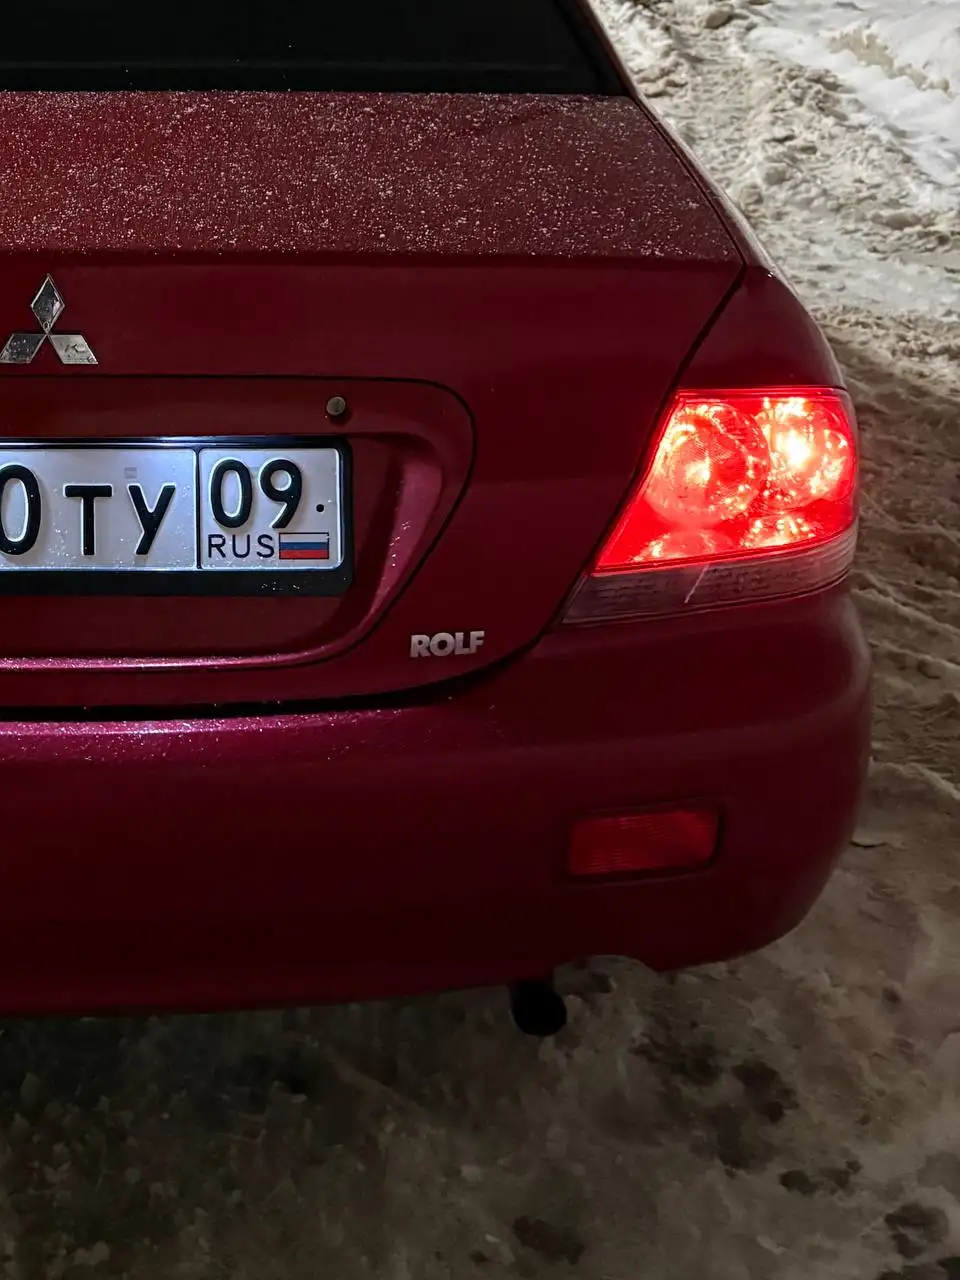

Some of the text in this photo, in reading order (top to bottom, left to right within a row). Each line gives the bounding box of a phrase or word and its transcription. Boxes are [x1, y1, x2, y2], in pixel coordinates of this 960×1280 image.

[209, 458, 302, 529] 09
[207, 533, 275, 559] RUS
[410, 630, 485, 658] ROLF
